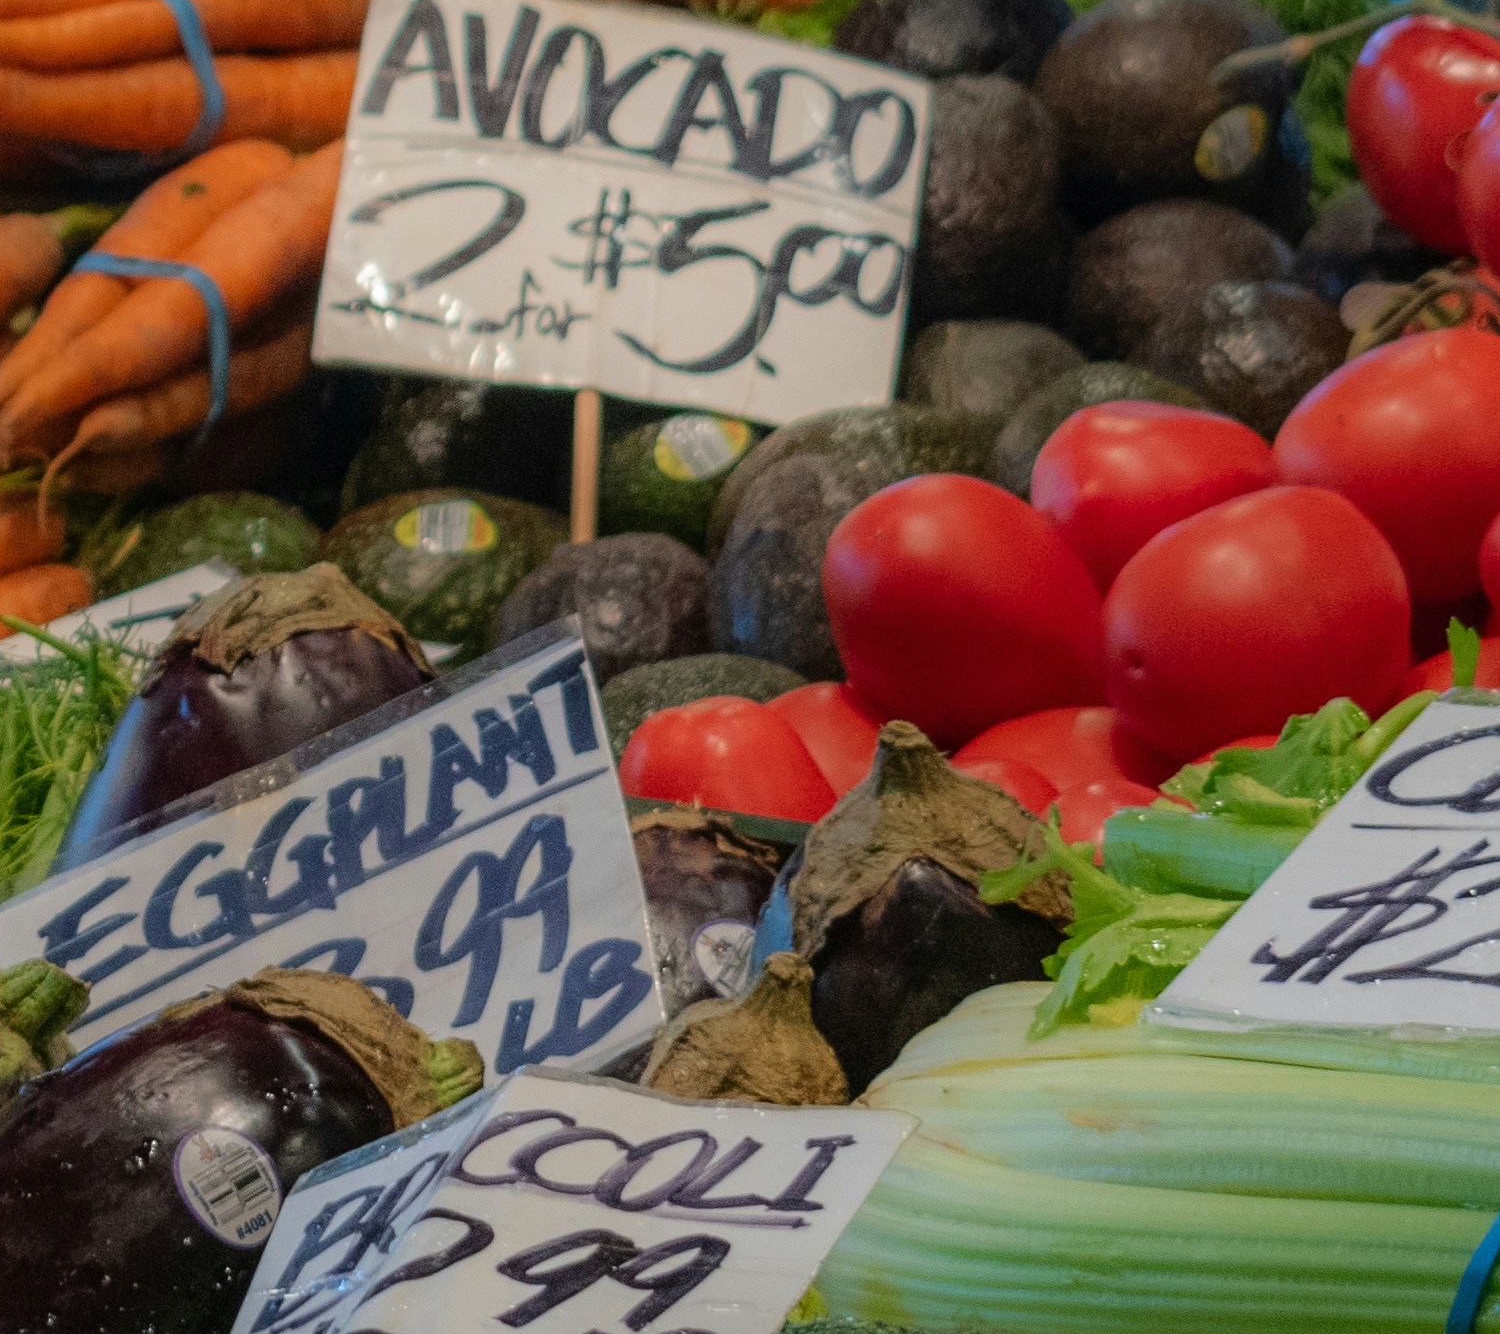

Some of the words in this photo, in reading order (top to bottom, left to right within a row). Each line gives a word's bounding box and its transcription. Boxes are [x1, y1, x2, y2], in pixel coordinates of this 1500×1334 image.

[328, 178, 526, 334] 2
[37, 649, 602, 988] EGGPLANT
[495, 938, 654, 1076] LB
[235, 1208, 275, 1241] #4081
